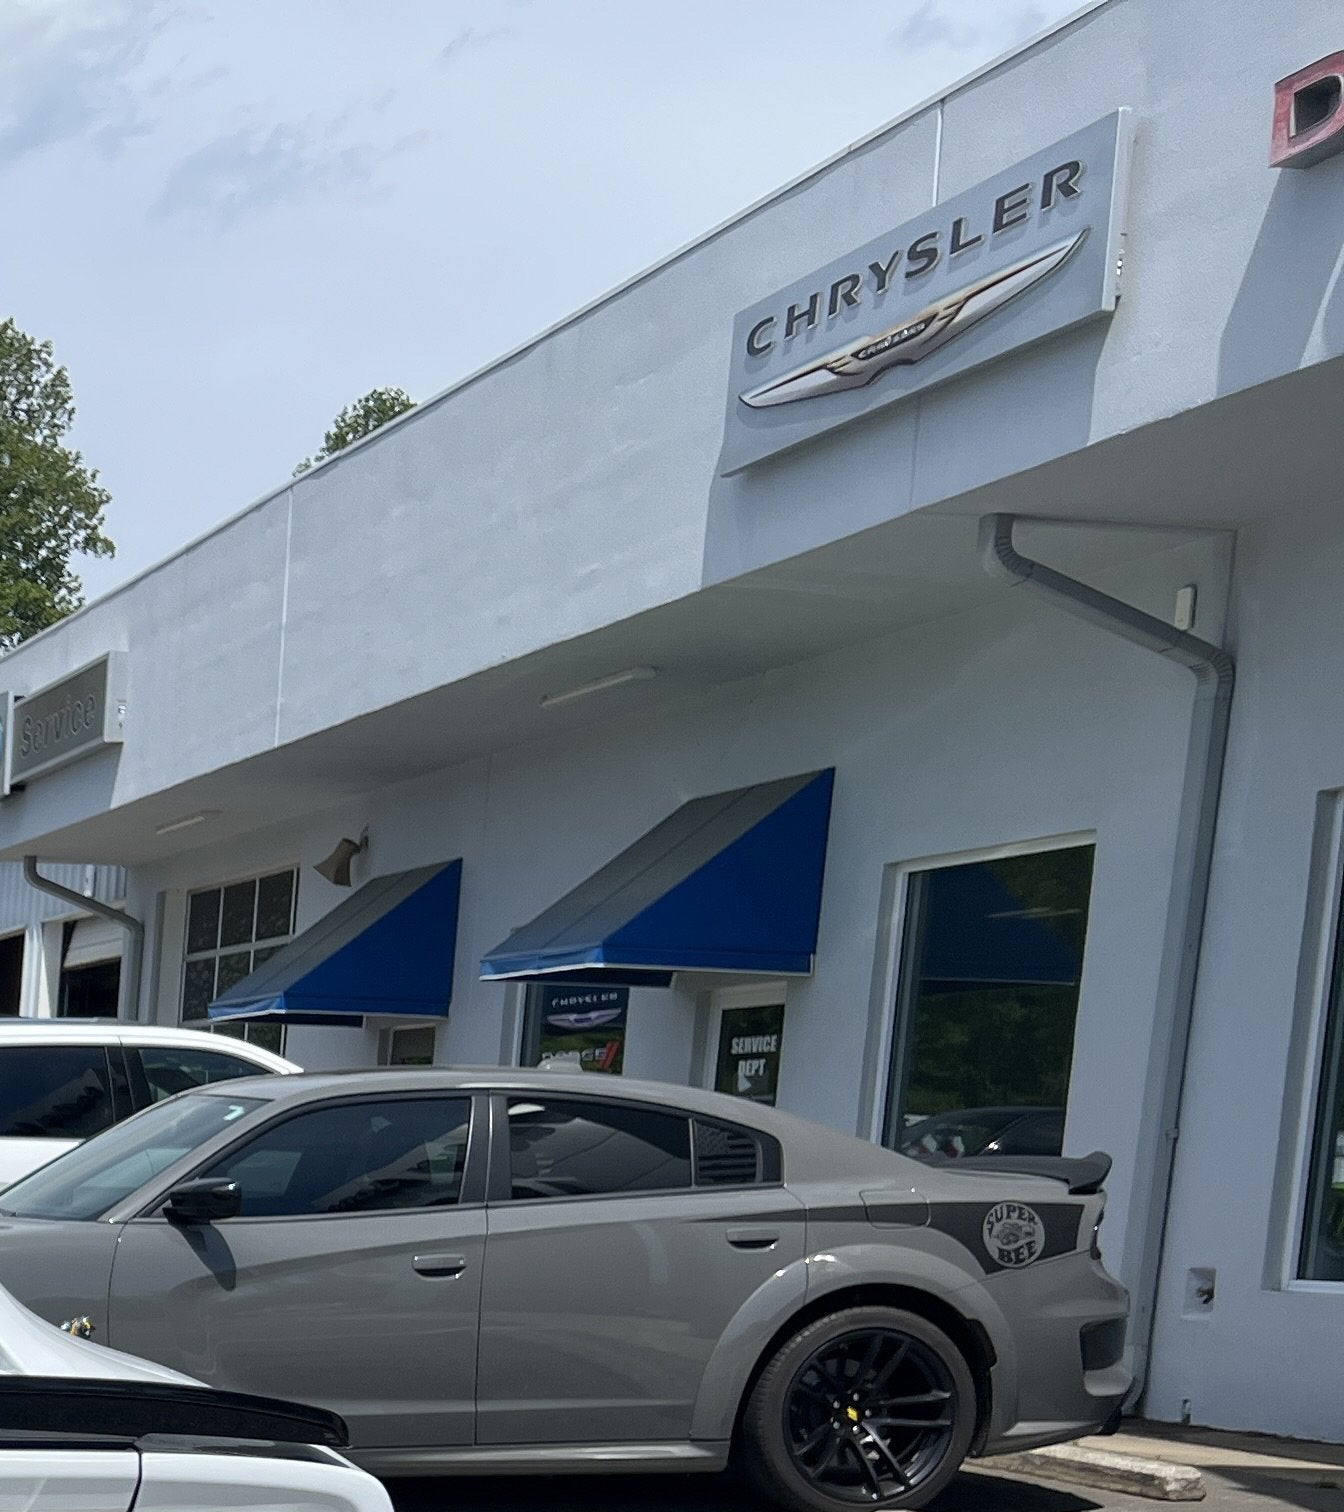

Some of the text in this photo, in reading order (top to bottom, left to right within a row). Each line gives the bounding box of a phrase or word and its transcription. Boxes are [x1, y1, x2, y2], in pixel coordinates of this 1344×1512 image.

[746, 158, 1088, 358] CHRYSLER
[20, 694, 95, 758] Service
[730, 1034, 778, 1055] SERVICE
[737, 1058, 767, 1077] DEPT
[986, 1204, 1039, 1239] SUPER
[997, 1240, 1039, 1265] BEE
